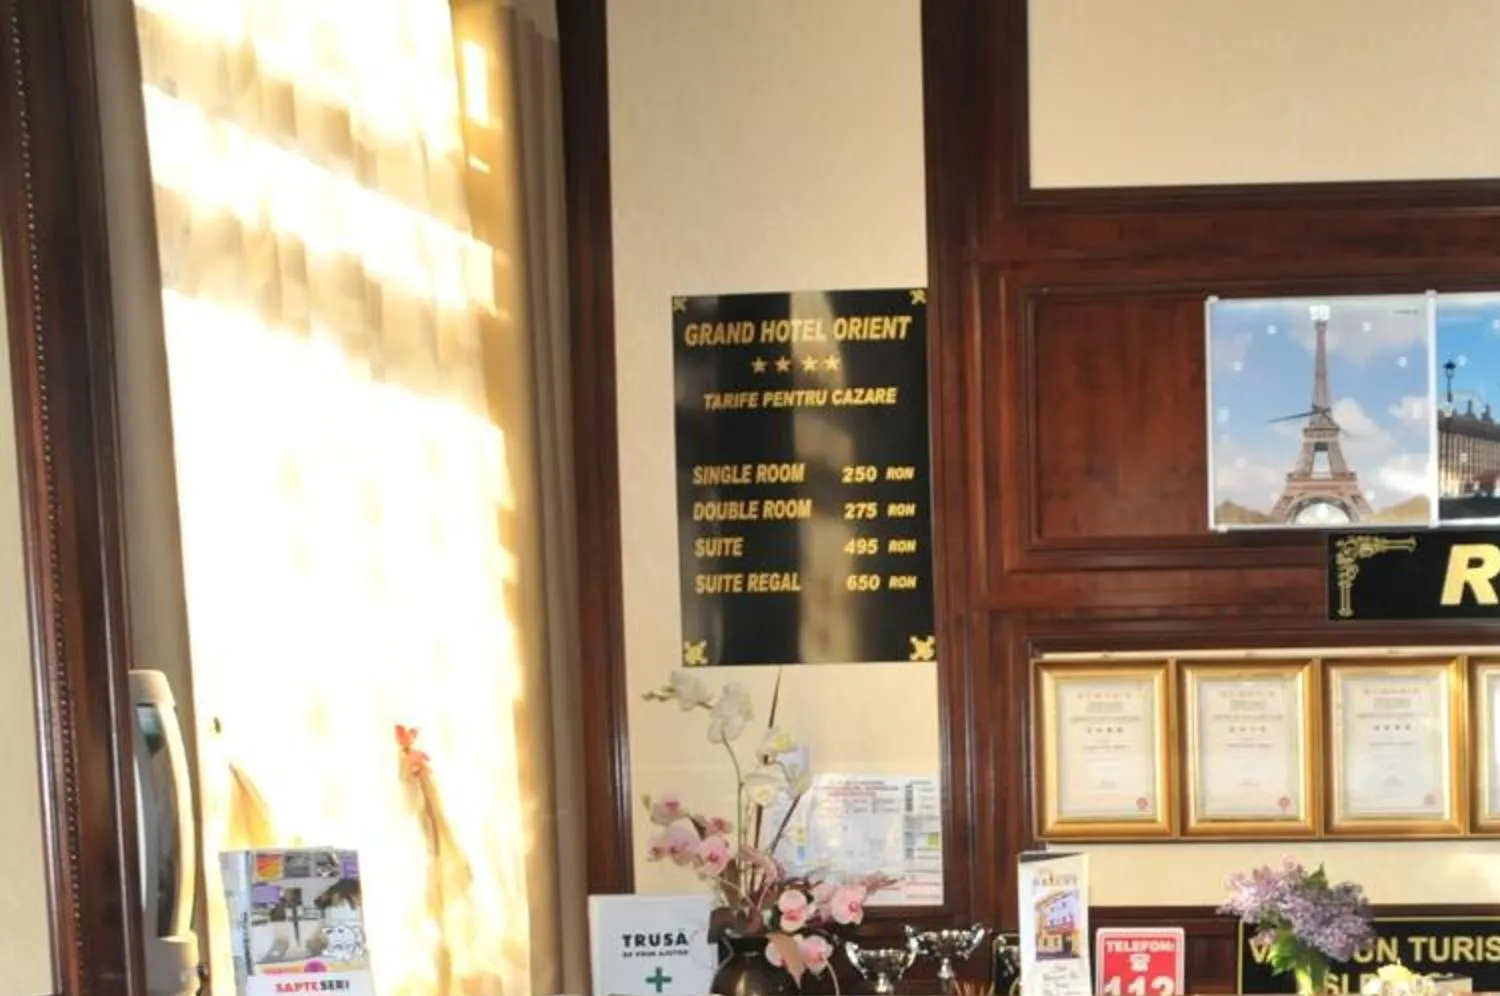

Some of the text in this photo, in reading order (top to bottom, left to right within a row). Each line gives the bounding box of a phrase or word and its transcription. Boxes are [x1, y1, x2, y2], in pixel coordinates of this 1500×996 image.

[684, 315, 912, 346] GRAND HOTEL ORIENT
[704, 387, 898, 411] TARIFE PENTRU CAZARE
[692, 463, 915, 485] SINGLE ROOM 250 RON
[693, 499, 916, 521] DOUBLE ROOM 275 RON
[694, 537, 917, 558] SUITE 495 RON
[694, 572, 917, 593] SUITE REGAL 650 RON
